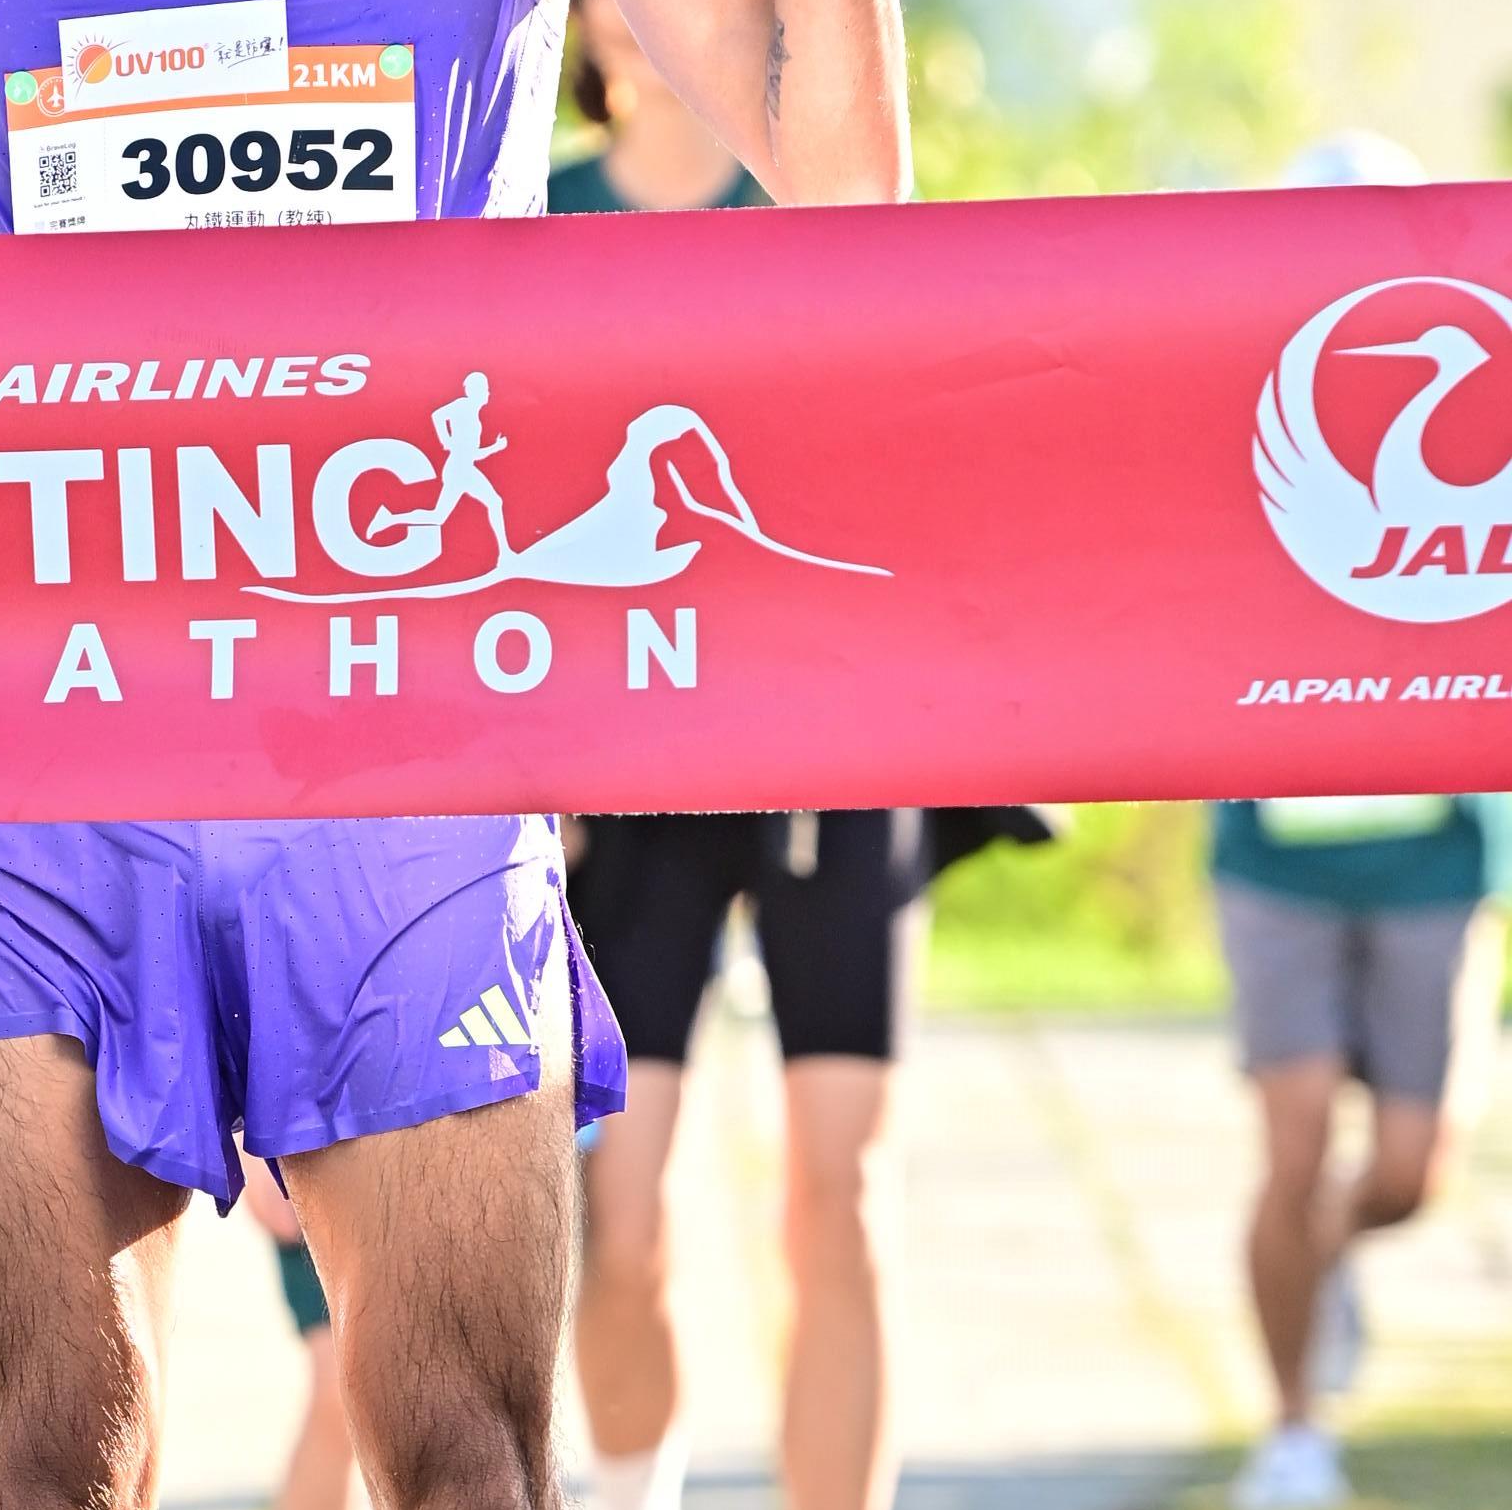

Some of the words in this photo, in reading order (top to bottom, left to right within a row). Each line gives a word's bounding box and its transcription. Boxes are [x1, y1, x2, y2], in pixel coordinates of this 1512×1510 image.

[115, 46, 205, 77] UV100
[293, 63, 377, 88] 21KM
[121, 128, 394, 200] 30952
[1350, 523, 1512, 579] JAL
[1236, 677, 1392, 705] JAPAN
[1398, 674, 1512, 701] AIRL
